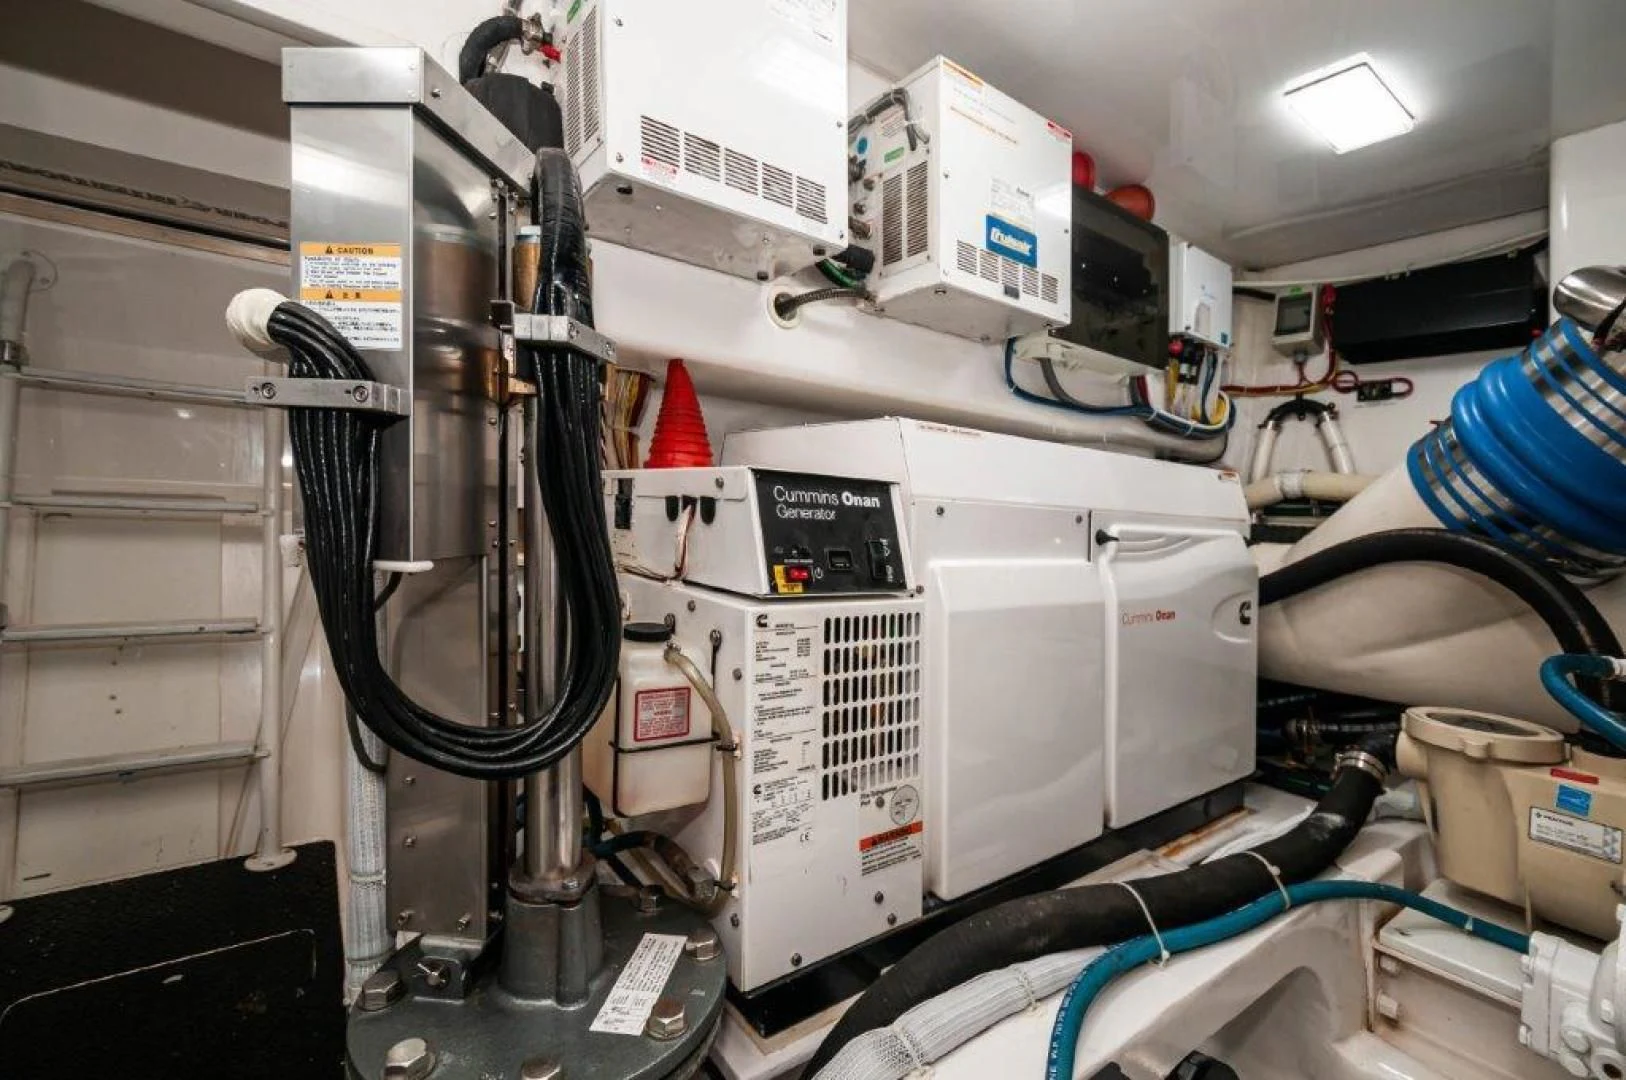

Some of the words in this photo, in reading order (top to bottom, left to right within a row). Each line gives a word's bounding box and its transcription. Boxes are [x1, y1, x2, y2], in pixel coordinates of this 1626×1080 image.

[337, 247, 374, 255] CAUTION
[773, 485, 839, 505] Cummins
[841, 491, 880, 508] Onan
[775, 504, 836, 520] Generator
[1155, 609, 1176, 621] Onan
